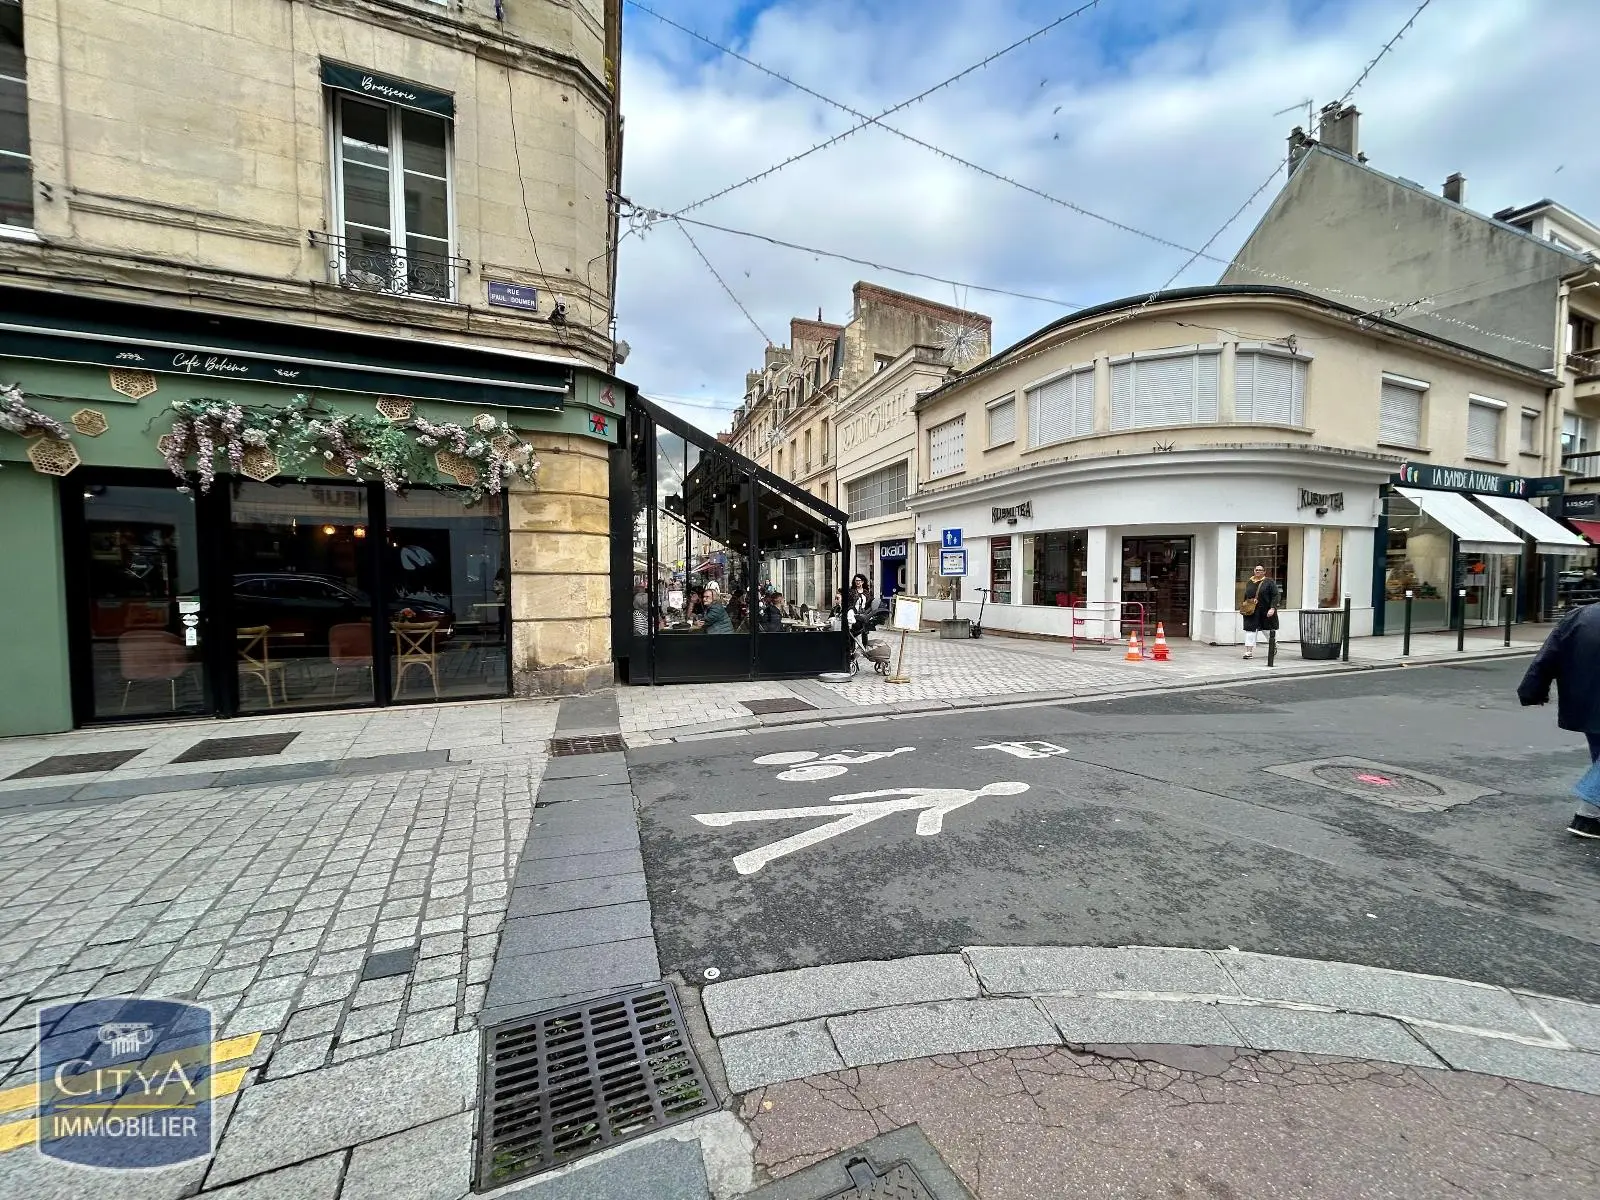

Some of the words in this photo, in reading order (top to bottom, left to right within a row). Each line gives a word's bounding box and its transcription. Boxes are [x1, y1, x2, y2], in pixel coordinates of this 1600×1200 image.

[361, 75, 417, 100] Brasserie
[491, 293, 507, 302] PAUL
[510, 296, 535, 307] DOUMER
[506, 287, 520, 296] RUE
[172, 352, 201, 373] Café
[1432, 468, 1442, 486] LA
[1444, 469, 1468, 489] BANDE
[1475, 473, 1500, 492] LAZARE
[1300, 489, 1328, 508] KUSMI
[1329, 491, 1344, 510] TEA
[991, 506, 1017, 524] KUSMI
[1016, 500, 1033, 518] TEA
